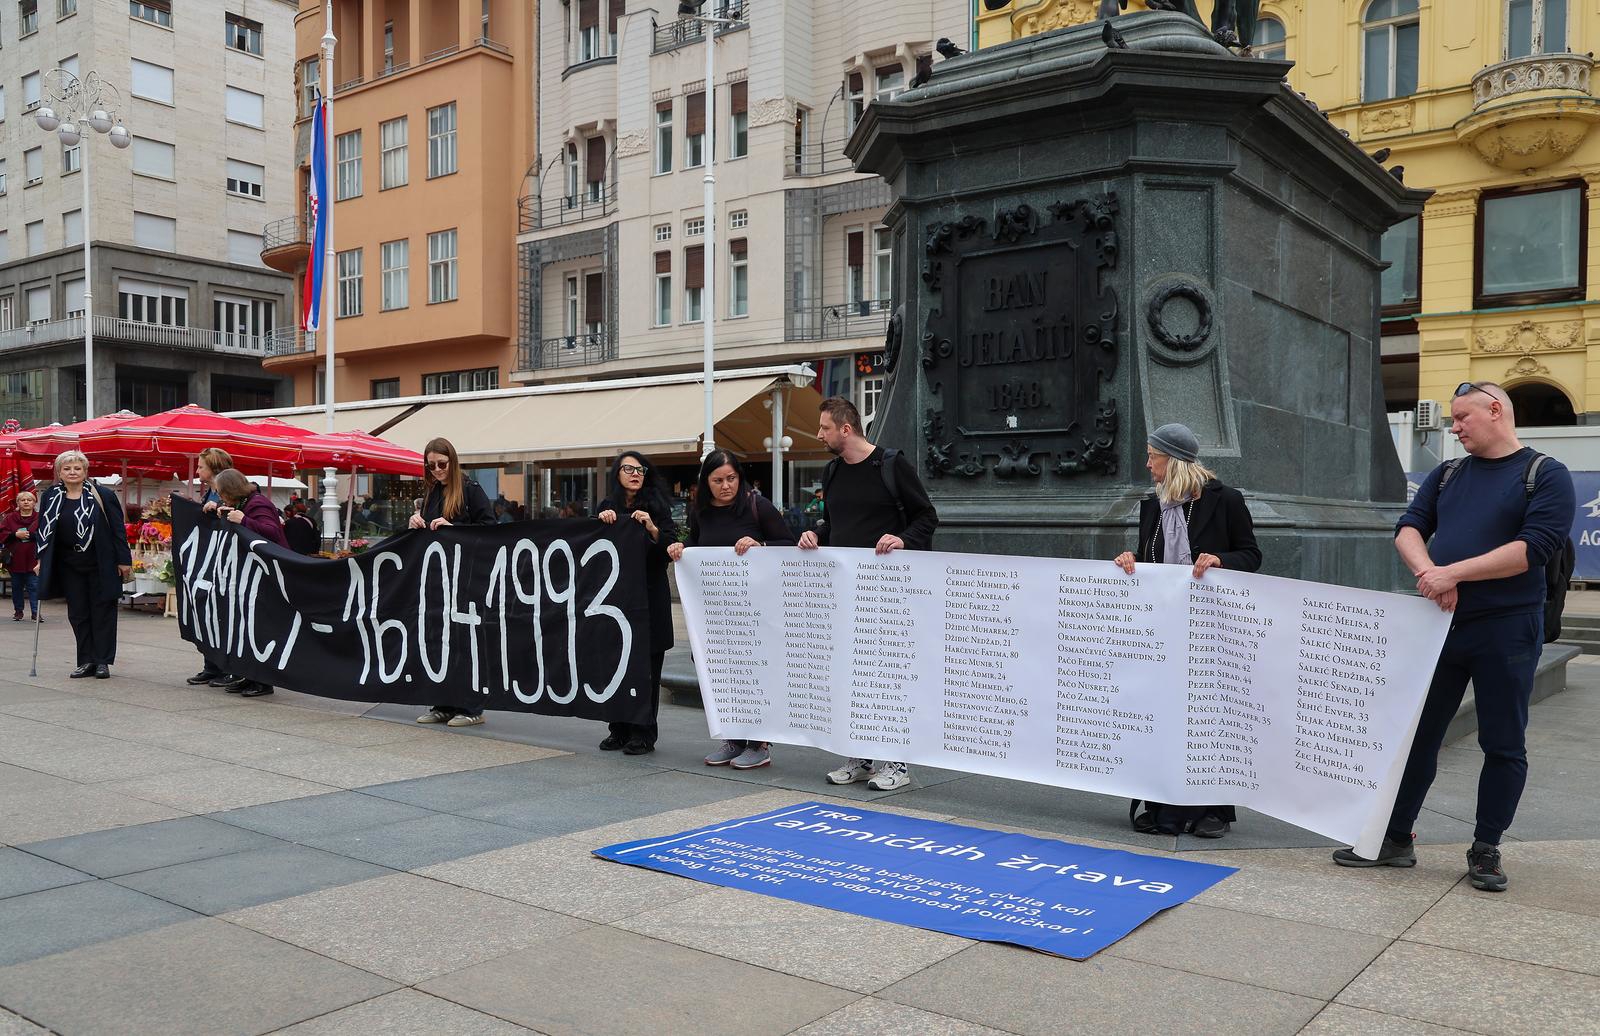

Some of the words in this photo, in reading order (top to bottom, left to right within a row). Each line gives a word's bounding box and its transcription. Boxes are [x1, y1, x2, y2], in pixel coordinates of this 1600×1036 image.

[983, 270, 1048, 312] BAN
[1059, 574, 1086, 583] KERMO
[1088, 576, 1129, 586] FAHRUDIN,
[1190, 582, 1214, 592] PEZER
[1216, 585, 1237, 596] FATA,
[1240, 589, 1250, 597] 43
[1059, 598, 1093, 608] MRKONJA
[1096, 600, 1142, 611] SABAHUDIN,
[1144, 604, 1153, 612] 38
[1190, 595, 1215, 603] PEZER
[1216, 598, 1243, 610] KASIM,
[1245, 602, 1255, 611] 64
[1303, 598, 1334, 609] SALKIĆ
[1336, 603, 1371, 616] FATIMA,
[1374, 609, 1385, 617] 32
[311, 621, 333, 633] -
[343, 538, 637, 705] 16.04.1993.
[1058, 610, 1093, 620] MRKONJA
[1096, 612, 1121, 622] SAMIR,
[1190, 607, 1215, 616] PEZER
[1217, 610, 1260, 625] MEVLUDIN,
[1263, 618, 1273, 626] 18
[1302, 611, 1333, 623] SALKIĆ
[1335, 616, 1371, 629] MELISA,
[1374, 622, 1379, 630] 8
[1058, 621, 1105, 632] NESLANOVIĆ
[1107, 625, 1143, 636] MEHMED,
[1189, 619, 1215, 628] PEZER
[1218, 622, 1254, 637] MUSTAFA,
[1256, 630, 1266, 638] 56
[1301, 624, 1332, 635] SALKIĆ
[1335, 629, 1373, 643] NERMIN,
[1377, 636, 1387, 645] 10
[1058, 633, 1104, 644] ORMANOVIĆ
[1106, 637, 1153, 649] ZEHRUDINA,
[1155, 642, 1164, 650] 27
[1301, 637, 1331, 649] SALKIĆ
[1334, 642, 1373, 657] NIHADA,
[1375, 649, 1386, 658] 33
[1058, 644, 1106, 656] OSMANČEVIĆ
[1108, 650, 1154, 662] SABAHUDIN,
[1157, 654, 1166, 662] 29
[1058, 656, 1076, 664] PAČO
[1078, 658, 1104, 668] FEHIM,
[1189, 644, 1215, 652] PEZER
[1218, 646, 1246, 659] OSMAN,
[1248, 653, 1256, 661] 31
[1300, 650, 1330, 662] SALKIĆ
[1333, 655, 1368, 669] OSMAN,
[1370, 662, 1380, 671] 62
[1299, 662, 1329, 674] SALKIĆ
[1332, 668, 1373, 684] REDŽIBA,
[1375, 677, 1385, 685] 55
[1298, 675, 1328, 687] SALKIĆ
[1331, 681, 1361, 695] SENAD,
[1365, 688, 1375, 696] 14
[1298, 687, 1323, 699] ŠEHIĆ
[1325, 693, 1351, 706] ELVIS,
[1355, 699, 1364, 707] 10
[1297, 699, 1322, 712] ŠEHIĆ
[1325, 706, 1356, 719] ENVER,
[1358, 713, 1368, 721] 33
[1296, 711, 1324, 725] ŠILJAK
[1326, 720, 1354, 732] ADEM,
[1356, 725, 1367, 734] 38
[1295, 737, 1311, 748] ZEC
[1314, 743, 1341, 755] ALISA,
[1345, 749, 1353, 757] 11
[1296, 725, 1325, 738] TRAKO
[1327, 732, 1370, 749] MEHMED,
[1373, 742, 1383, 751] 53
[1295, 749, 1311, 760] ZEC
[1314, 754, 1350, 770] HAJRIJA,
[1353, 764, 1363, 772] 40
[1219, 766, 1247, 776] ADISA,
[1295, 761, 1310, 772] ZEC
[1313, 767, 1365, 787] SABAHUDIN,
[1367, 781, 1377, 789] 36
[813, 809, 862, 822] TRG
[774, 816, 986, 862] ahmićkih
[995, 854, 1173, 894] žrtava
[704, 837, 753, 850] Ratni
[807, 857, 846, 867] nad
[846, 863, 874, 873] 116
[875, 869, 983, 895] bošnjačkih
[988, 892, 1045, 907] civila
[1051, 903, 1096, 916] koji
[706, 848, 779, 863] počinile
[777, 861, 871, 882] postrojbe
[874, 878, 942, 897] HVO-a
[947, 892, 1041, 917] 16.4.1993.
[707, 865, 750, 878] vrha
[750, 873, 786, 885] RH.
[666, 847, 721, 860] MKSJ
[712, 857, 737, 865] je
[739, 862, 829, 883] ustanovio
[832, 881, 962, 911] odgovornost
[961, 907, 1077, 934] političkog
